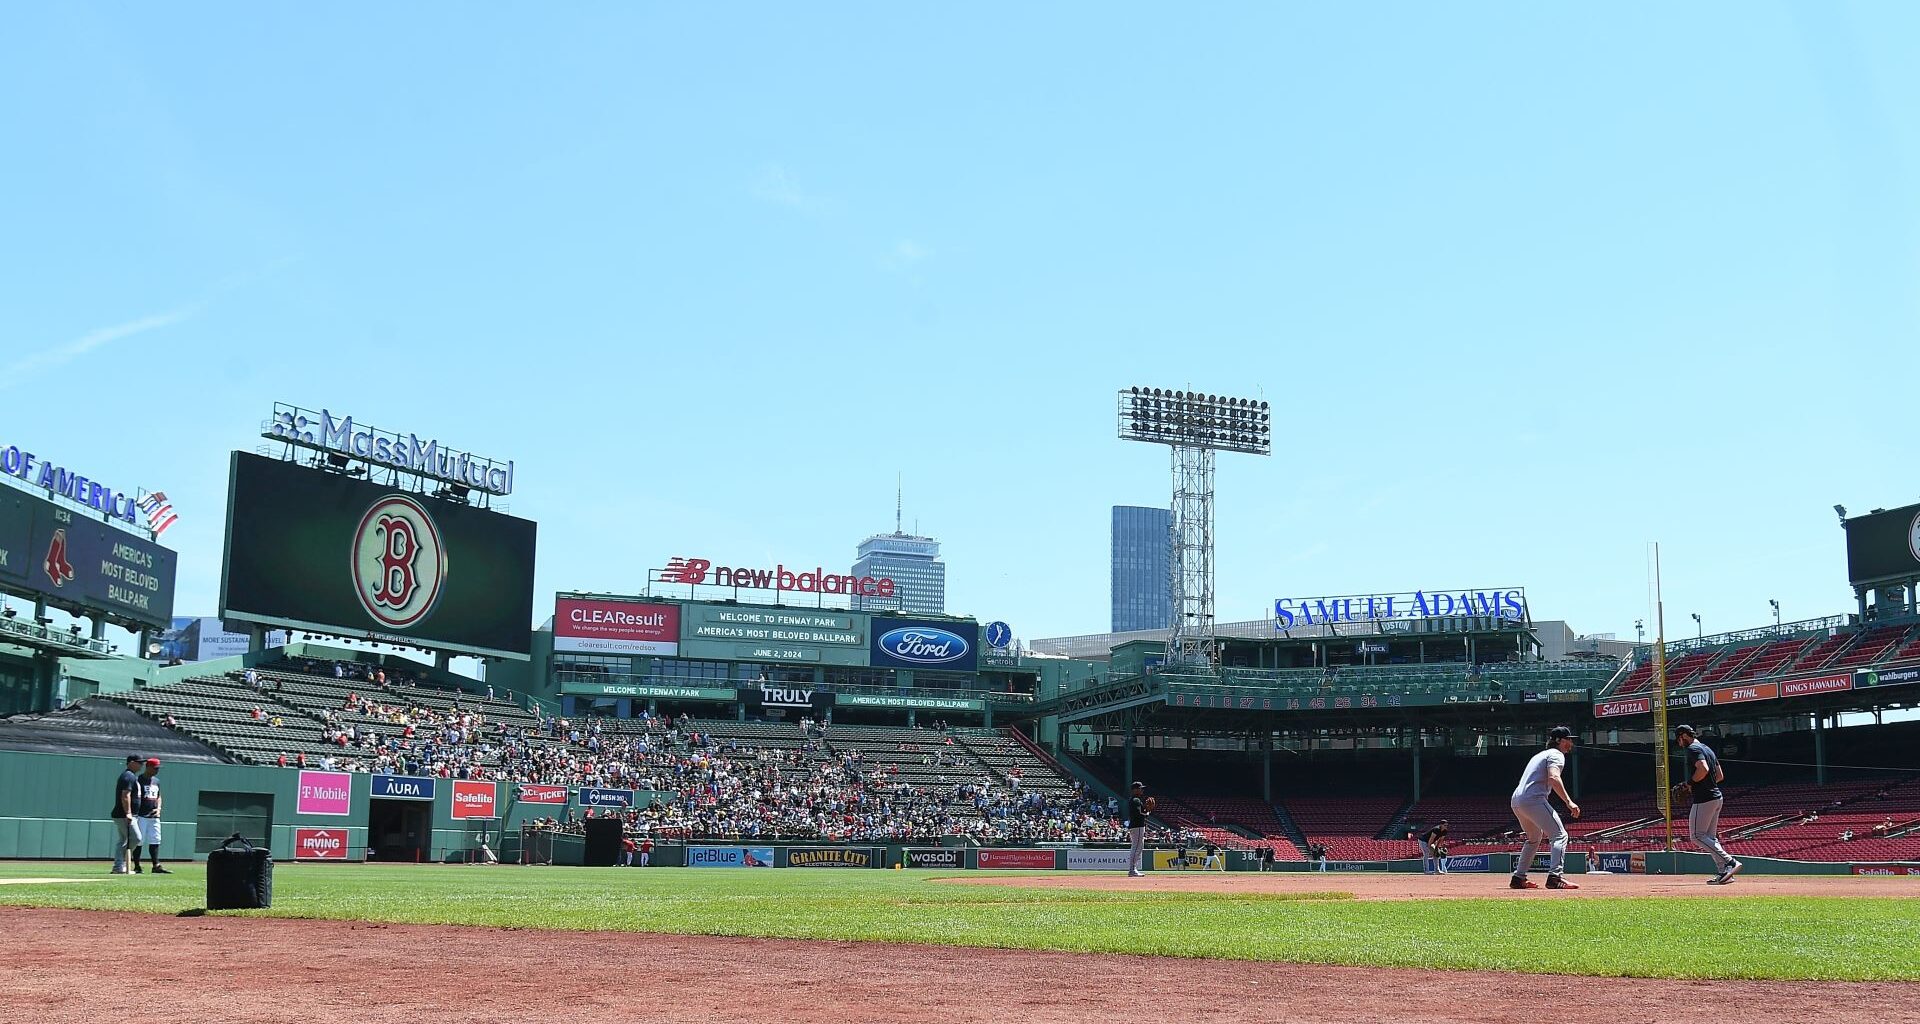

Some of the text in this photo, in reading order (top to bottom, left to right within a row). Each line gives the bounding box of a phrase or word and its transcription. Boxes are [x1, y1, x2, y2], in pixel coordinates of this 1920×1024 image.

[318, 409, 514, 494] MassMutual
[2, 445, 136, 523] OF AMERICA
[112, 542, 153, 568] AMERICA'S
[101, 559, 159, 592] MOST BELOVED
[715, 564, 895, 598] new balance
[108, 584, 149, 609] BALLPARK
[1275, 590, 1523, 631] SAMUEL ADAMS
[570, 609, 664, 627] CLEAResult
[719, 612, 836, 627] WELCOME TO FENWAY PARK
[1381, 620, 1411, 632] OSTON
[697, 627, 857, 643] AMERICA'S MOST BELOVED BALLPARK
[578, 641, 657, 651] clearesult.com/redsox
[896, 631, 951, 657] Ford
[753, 649, 802, 659] JUNE 2, 2024
[1879, 669, 1919, 682] wahlburgers
[1809, 678, 1846, 690] HAWAIIAN
[603, 686, 700, 697] WELCOME TO FENWAY PARK
[763, 688, 813, 703] TRULY
[1691, 693, 1708, 704] GIN
[1732, 688, 1758, 699] STIHL
[852, 696, 969, 708] AMERICA'S MOST BELOVED BALLPARK
[1193, 695, 1200, 707] 4
[1209, 696, 1215, 708] 1
[1240, 697, 1255, 709] 27
[1287, 698, 1299, 710] 14
[1309, 698, 1326, 709] 45
[1361, 695, 1378, 708] 34
[1387, 695, 1401, 707] 42
[1601, 703, 1643, 716] Sal's PIZZA
[313, 786, 347, 800] Mobile
[455, 792, 493, 804] Safelite
[539, 790, 566, 801] TICKET
[303, 838, 340, 849] IRVING
[475, 833, 490, 843] 40
[691, 849, 737, 864] jetBlue
[790, 849, 872, 865] GRANITE CITY
[910, 850, 957, 862] wasabi
[1447, 857, 1482, 869] Jordan's
[1603, 857, 1628, 872] KAYEM
